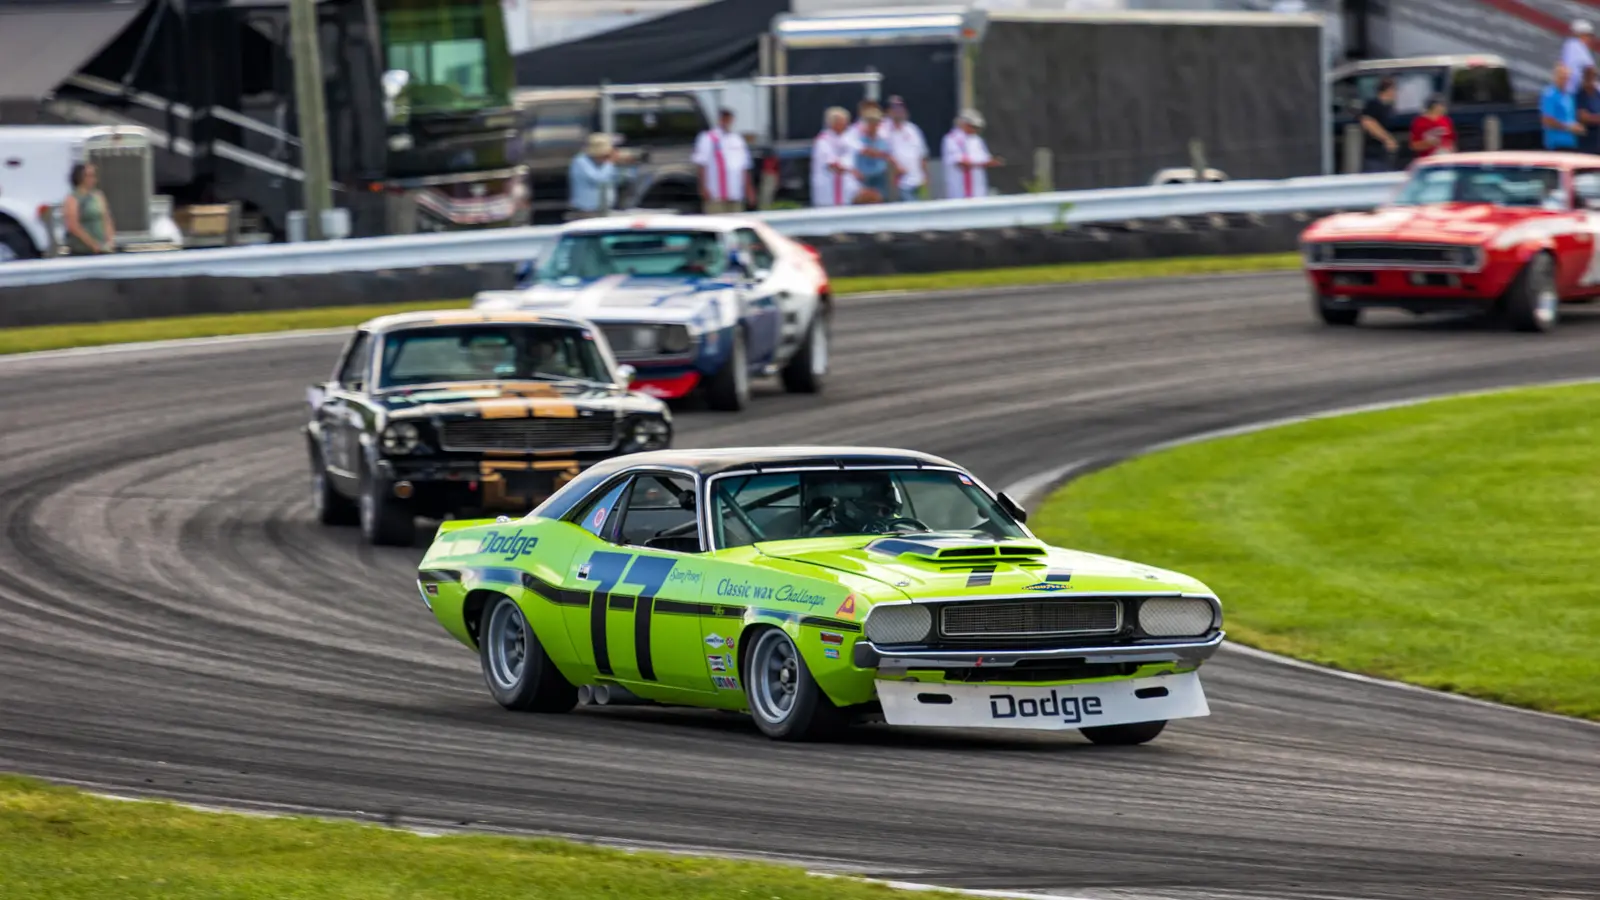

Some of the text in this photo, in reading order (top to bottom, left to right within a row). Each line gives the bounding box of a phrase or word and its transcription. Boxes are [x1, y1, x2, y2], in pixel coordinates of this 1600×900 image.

[480, 529, 538, 561] Dodge
[717, 578, 826, 611] Classic wax Challenger
[587, 551, 677, 680] 77
[989, 689, 1104, 723] Dodge
